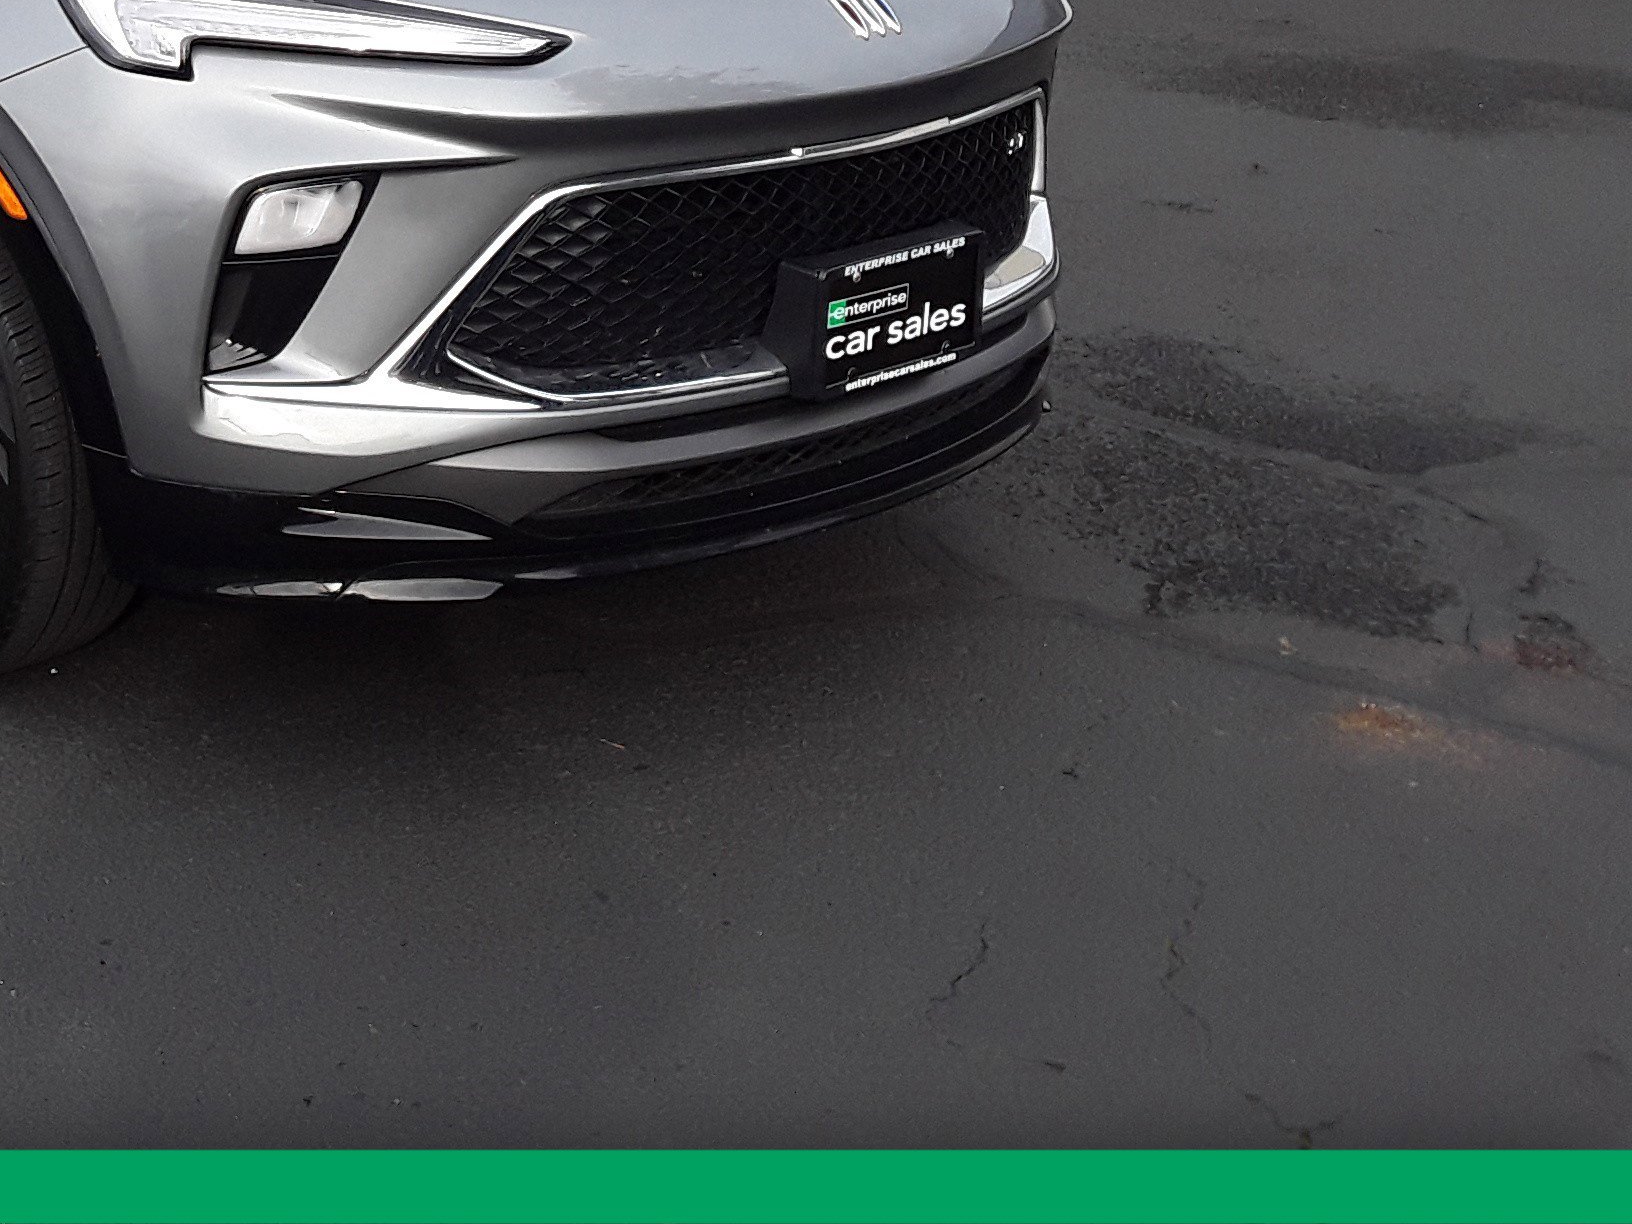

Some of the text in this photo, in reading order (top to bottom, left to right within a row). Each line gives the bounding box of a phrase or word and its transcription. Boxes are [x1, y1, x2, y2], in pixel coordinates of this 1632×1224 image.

[844, 237, 966, 276] ENTERPRISE CAR SALES
[833, 291, 907, 320] enterprise
[825, 301, 967, 360] car sales
[845, 352, 957, 392] enterprisecarsales.com
